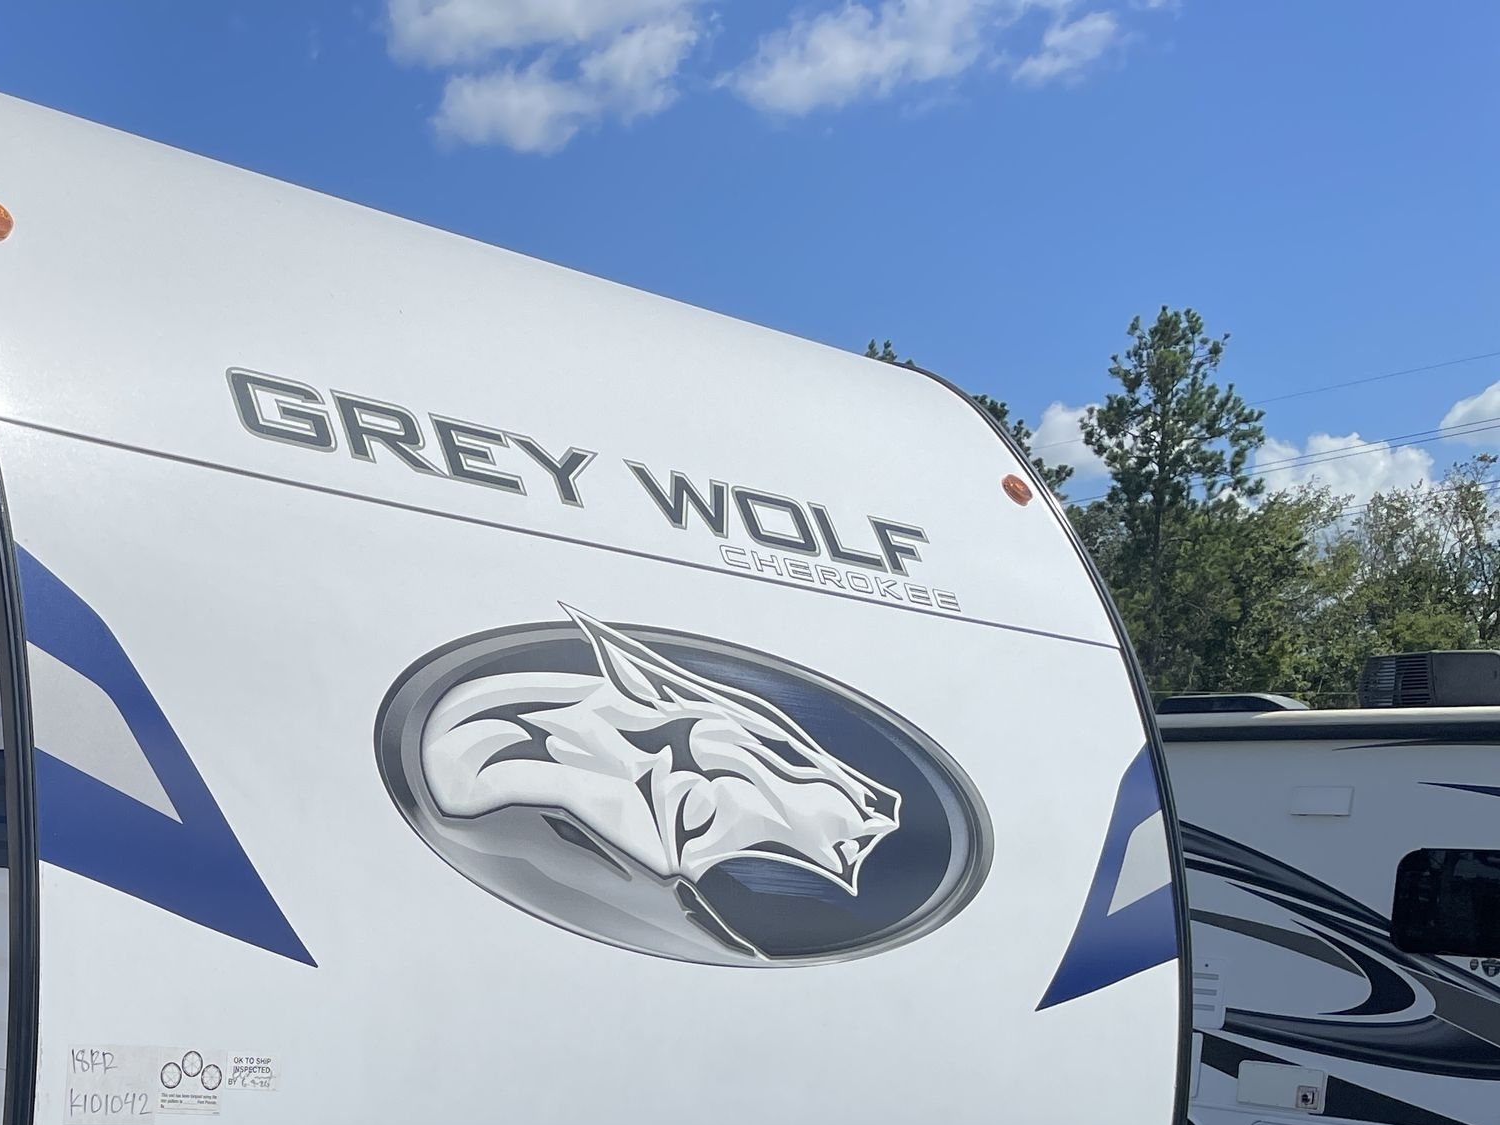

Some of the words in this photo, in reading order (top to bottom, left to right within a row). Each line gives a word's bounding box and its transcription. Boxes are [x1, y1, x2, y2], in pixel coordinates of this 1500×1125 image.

[226, 367, 598, 508] GREY
[623, 459, 930, 576] WOLF
[719, 545, 962, 611] CHEROKEE
[232, 1065, 271, 1074] INSPECTED
[233, 1056, 243, 1064] OK
[245, 1057, 255, 1065] TO
[256, 1057, 272, 1065] SHIP
[70, 1088, 153, 1117] K101042
